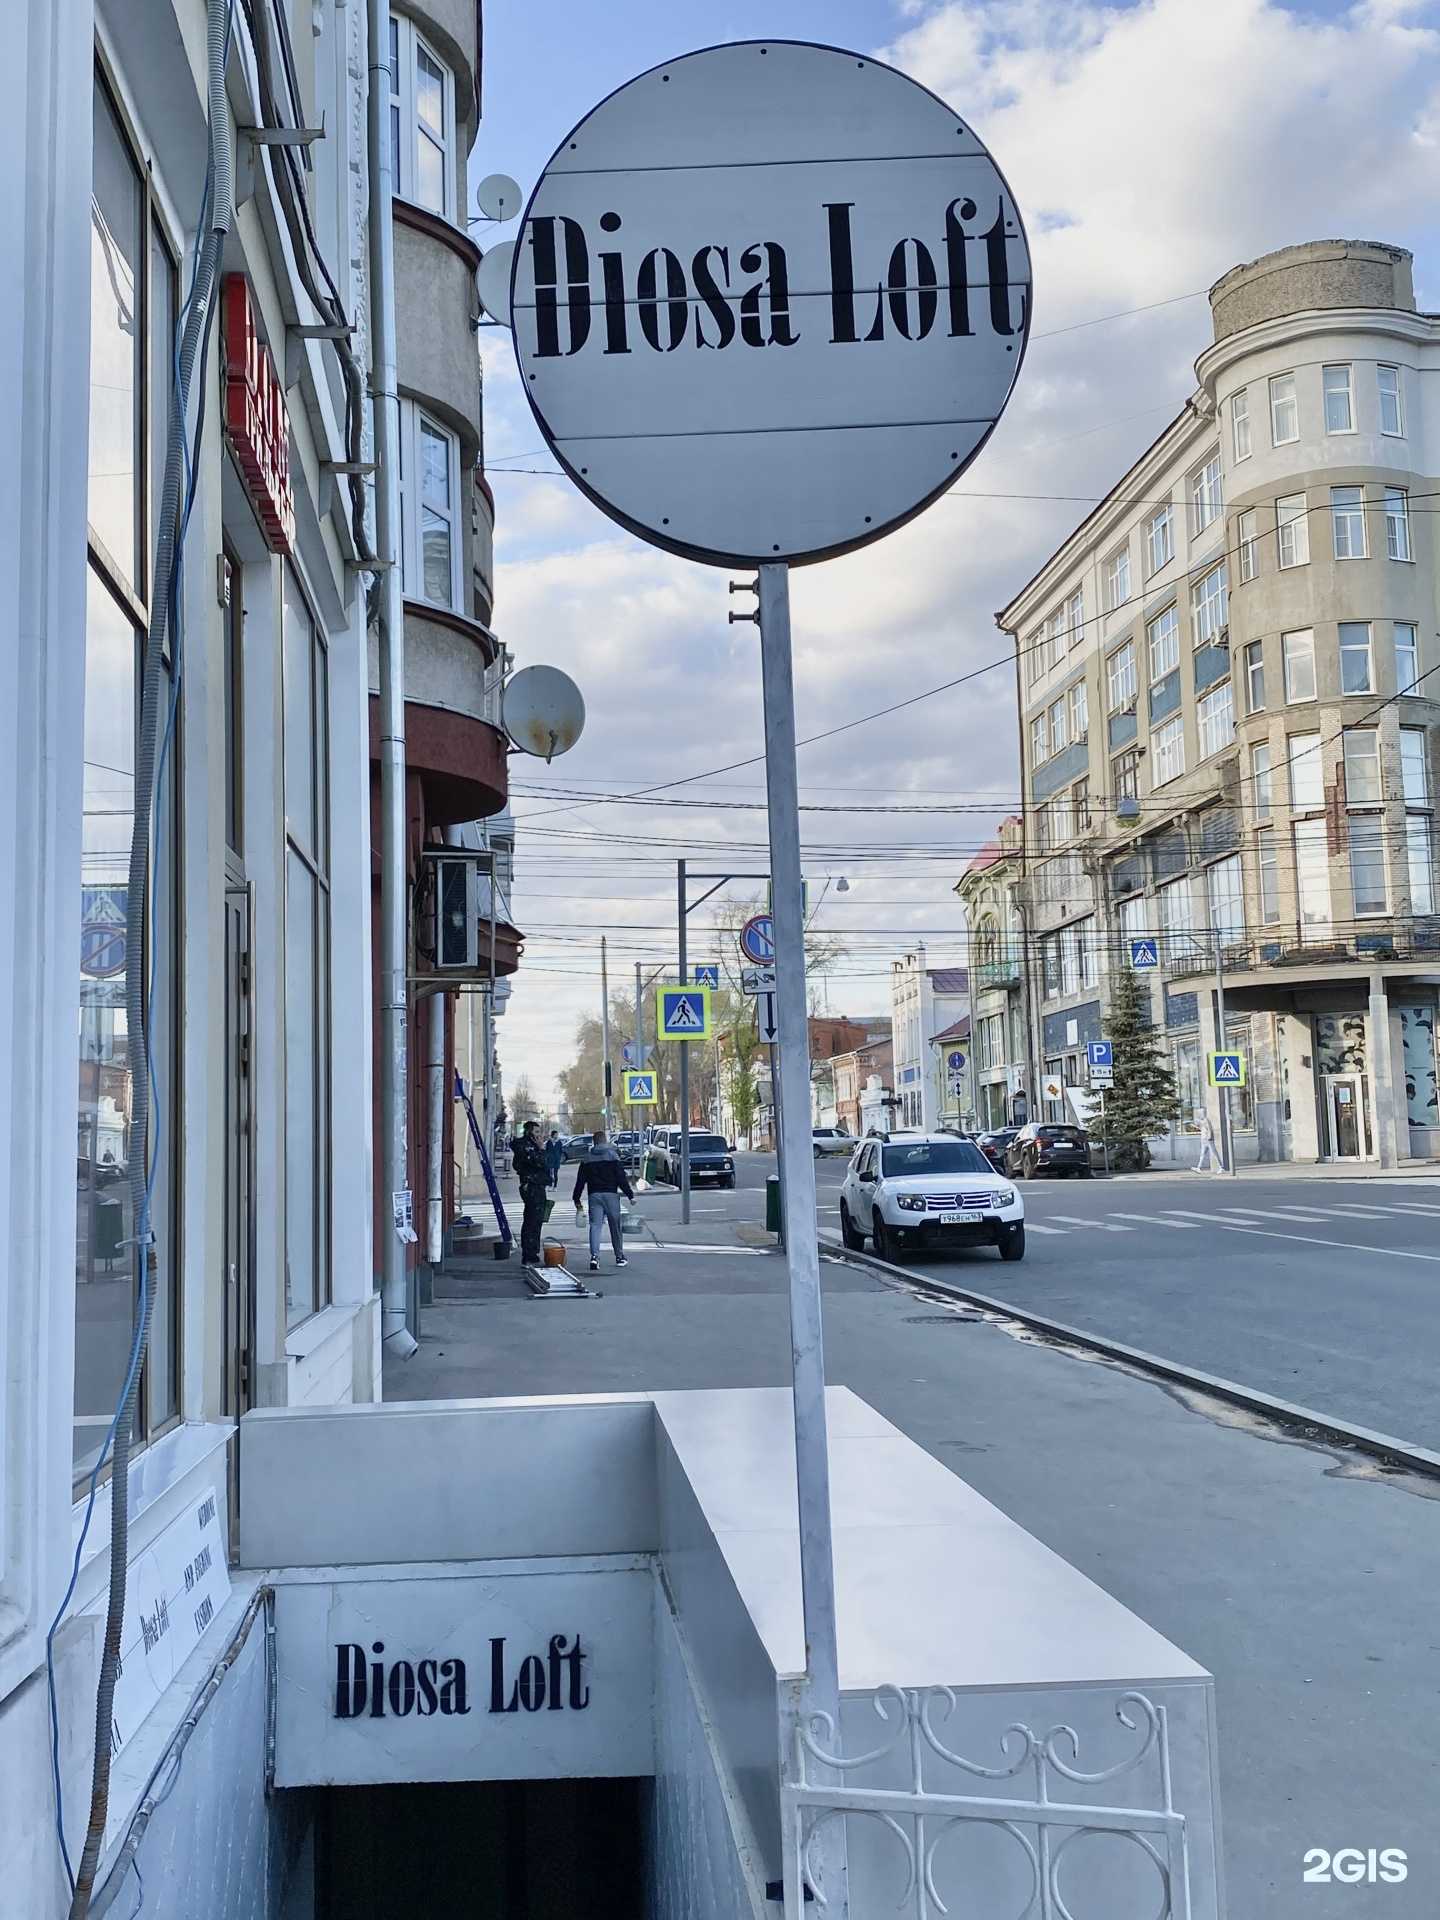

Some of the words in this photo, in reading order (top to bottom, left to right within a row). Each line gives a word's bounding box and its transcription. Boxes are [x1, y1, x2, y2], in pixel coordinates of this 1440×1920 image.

[527, 210, 800, 358] Diosa
[822, 194, 1026, 345] Loft
[1093, 1044, 1107, 1063] P
[333, 1641, 472, 1719] Diosa
[488, 1633, 590, 1714] Loft
